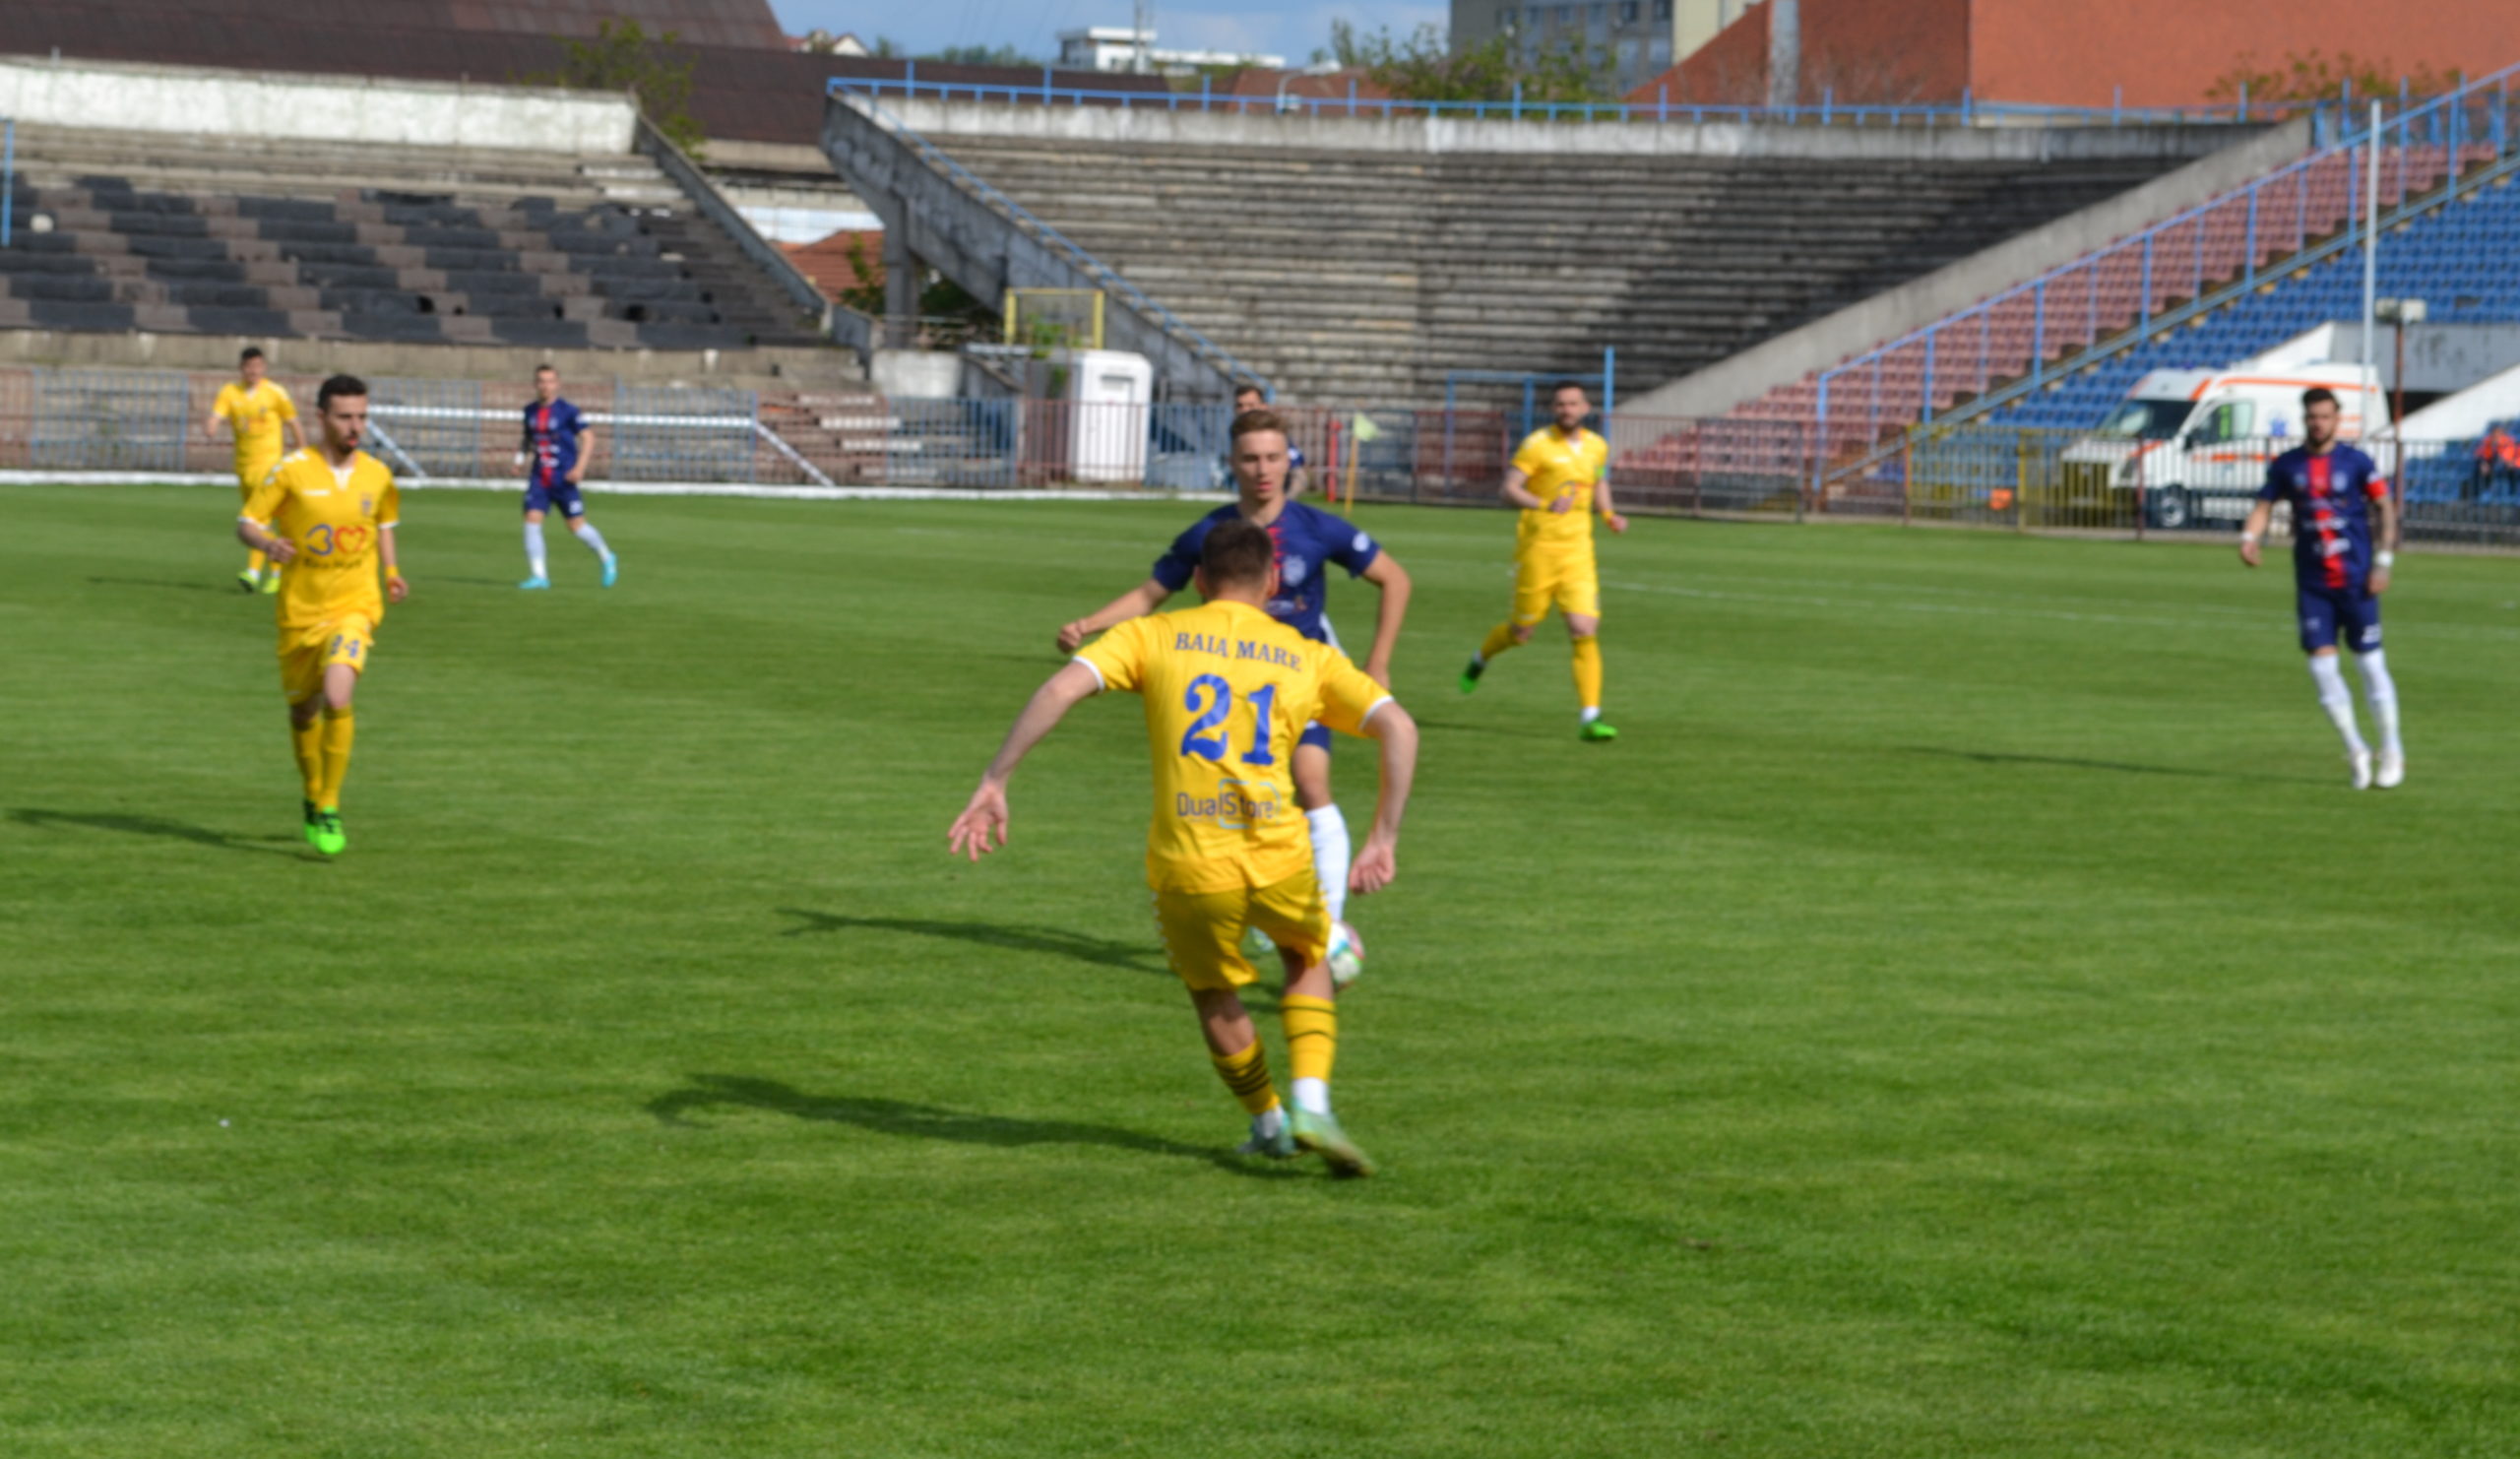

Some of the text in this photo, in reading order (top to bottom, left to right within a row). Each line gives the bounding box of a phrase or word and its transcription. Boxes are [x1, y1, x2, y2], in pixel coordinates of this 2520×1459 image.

[1174, 632, 1302, 672] BAIA MARE
[1180, 673, 1276, 766] 21
[1176, 792, 1275, 819] DualStore
